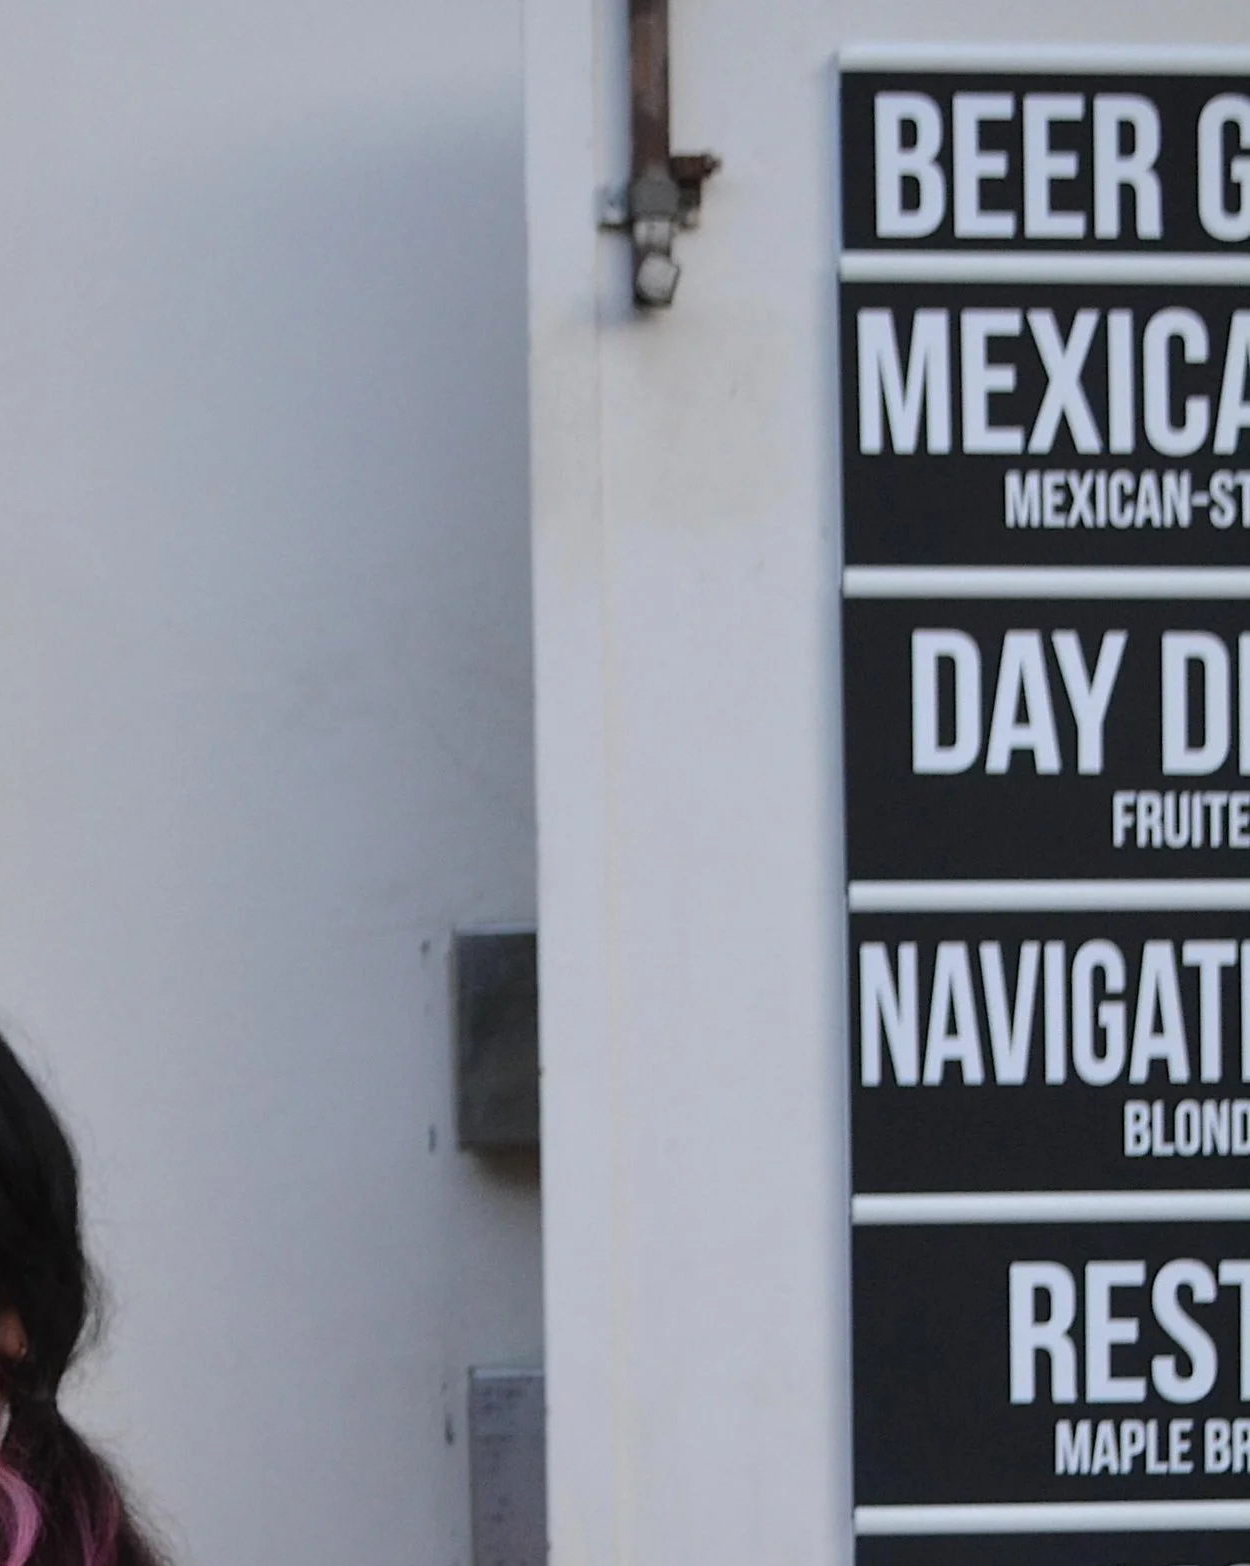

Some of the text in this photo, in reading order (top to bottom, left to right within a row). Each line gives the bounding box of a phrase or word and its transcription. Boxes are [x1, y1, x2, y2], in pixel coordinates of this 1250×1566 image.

[875, 93, 1161, 238] BEER
[912, 630, 1250, 775] DAY D
[1056, 1420, 1193, 1474] MAPLE
